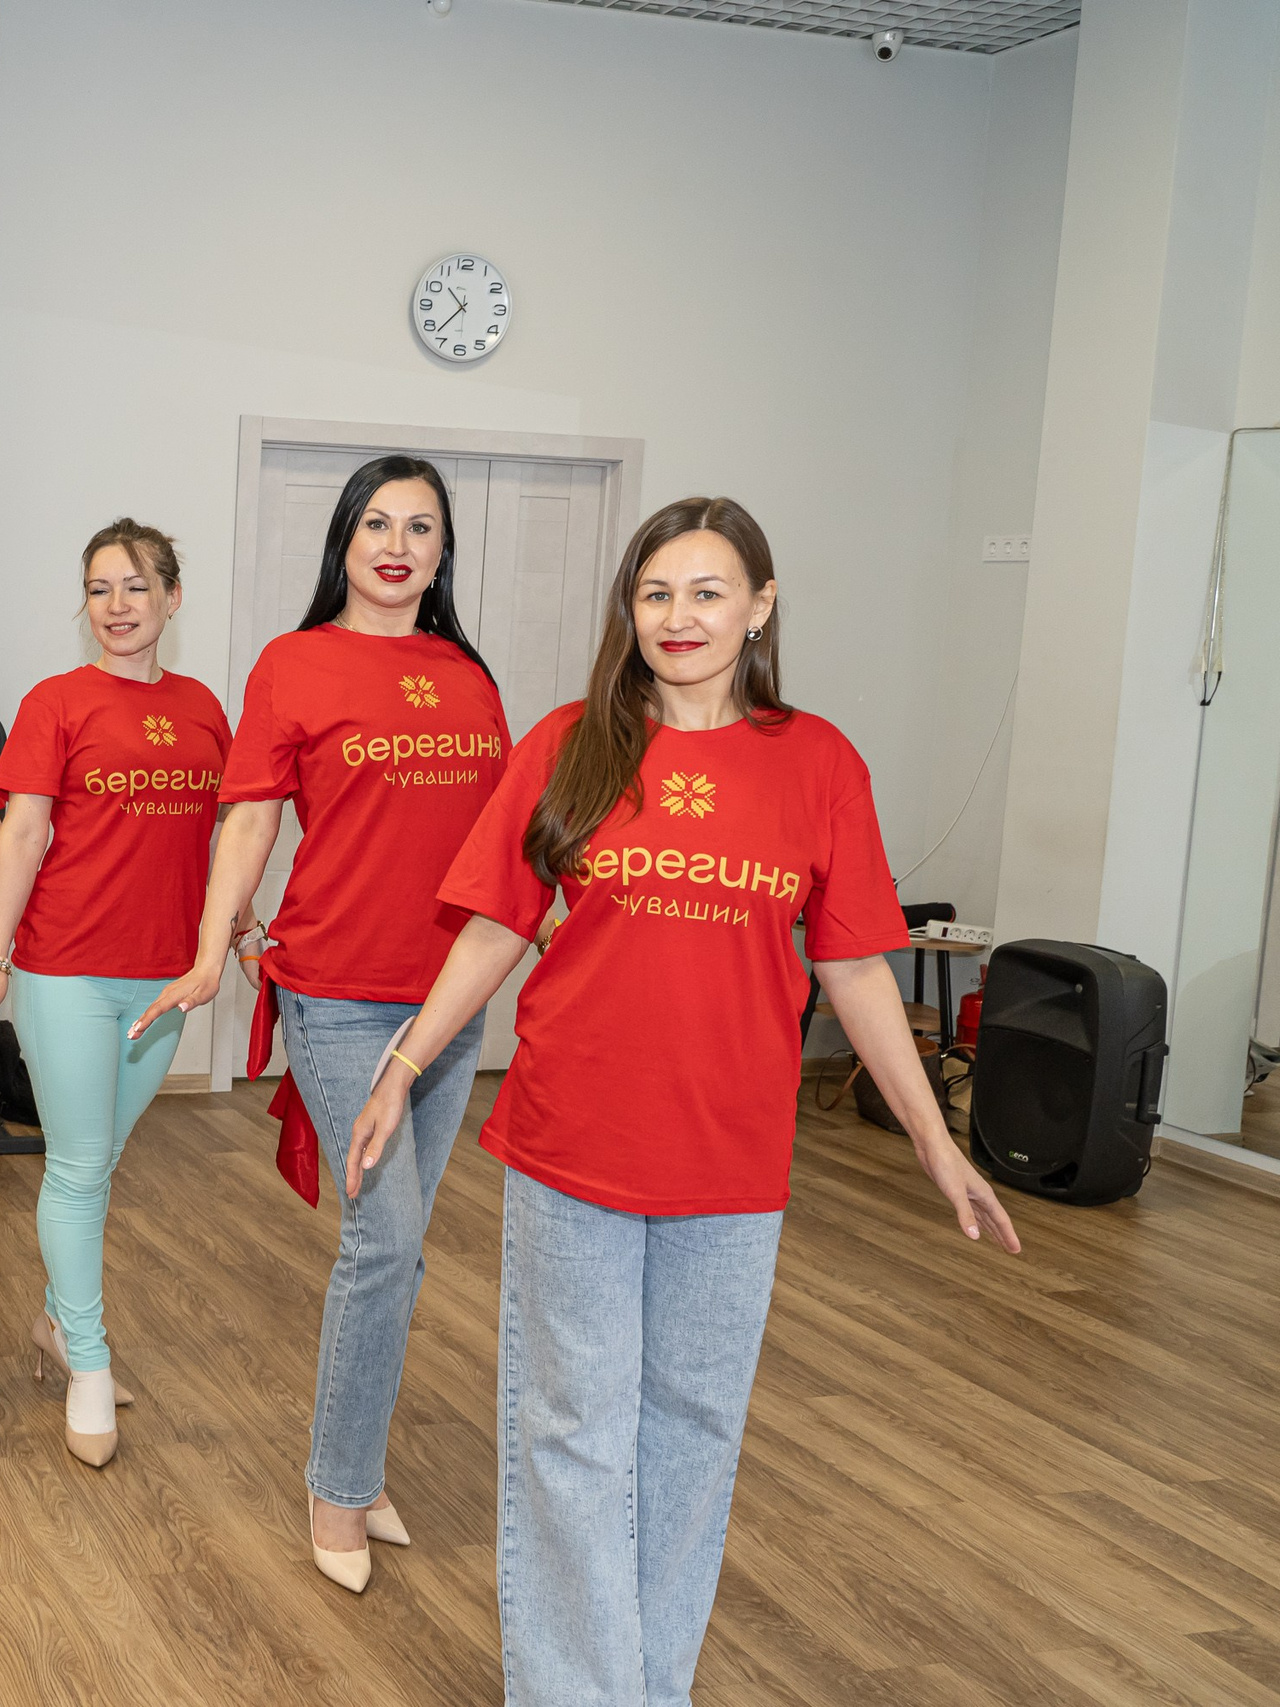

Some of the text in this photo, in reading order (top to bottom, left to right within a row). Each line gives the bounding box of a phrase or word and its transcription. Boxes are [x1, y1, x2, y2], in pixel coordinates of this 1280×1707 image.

[440, 265, 451, 277] 11
[457, 258, 475, 271] 12
[484, 265, 488, 277] 1
[425, 280, 443, 293] 10
[489, 282, 503, 294] 2
[419, 298, 433, 311] 9
[493, 304, 507, 316] 3
[423, 319, 437, 332] 8
[486, 324, 499, 336] 4
[435, 337, 448, 348] 7
[473, 339, 486, 351] 5
[453, 344, 467, 356] 6
[342, 733, 502, 767] берегиня
[84, 767, 224, 797] берегин
[383, 769, 479, 789] чувашии
[120, 801, 204, 817] чувашии
[610, 894, 750, 928] чувашии
